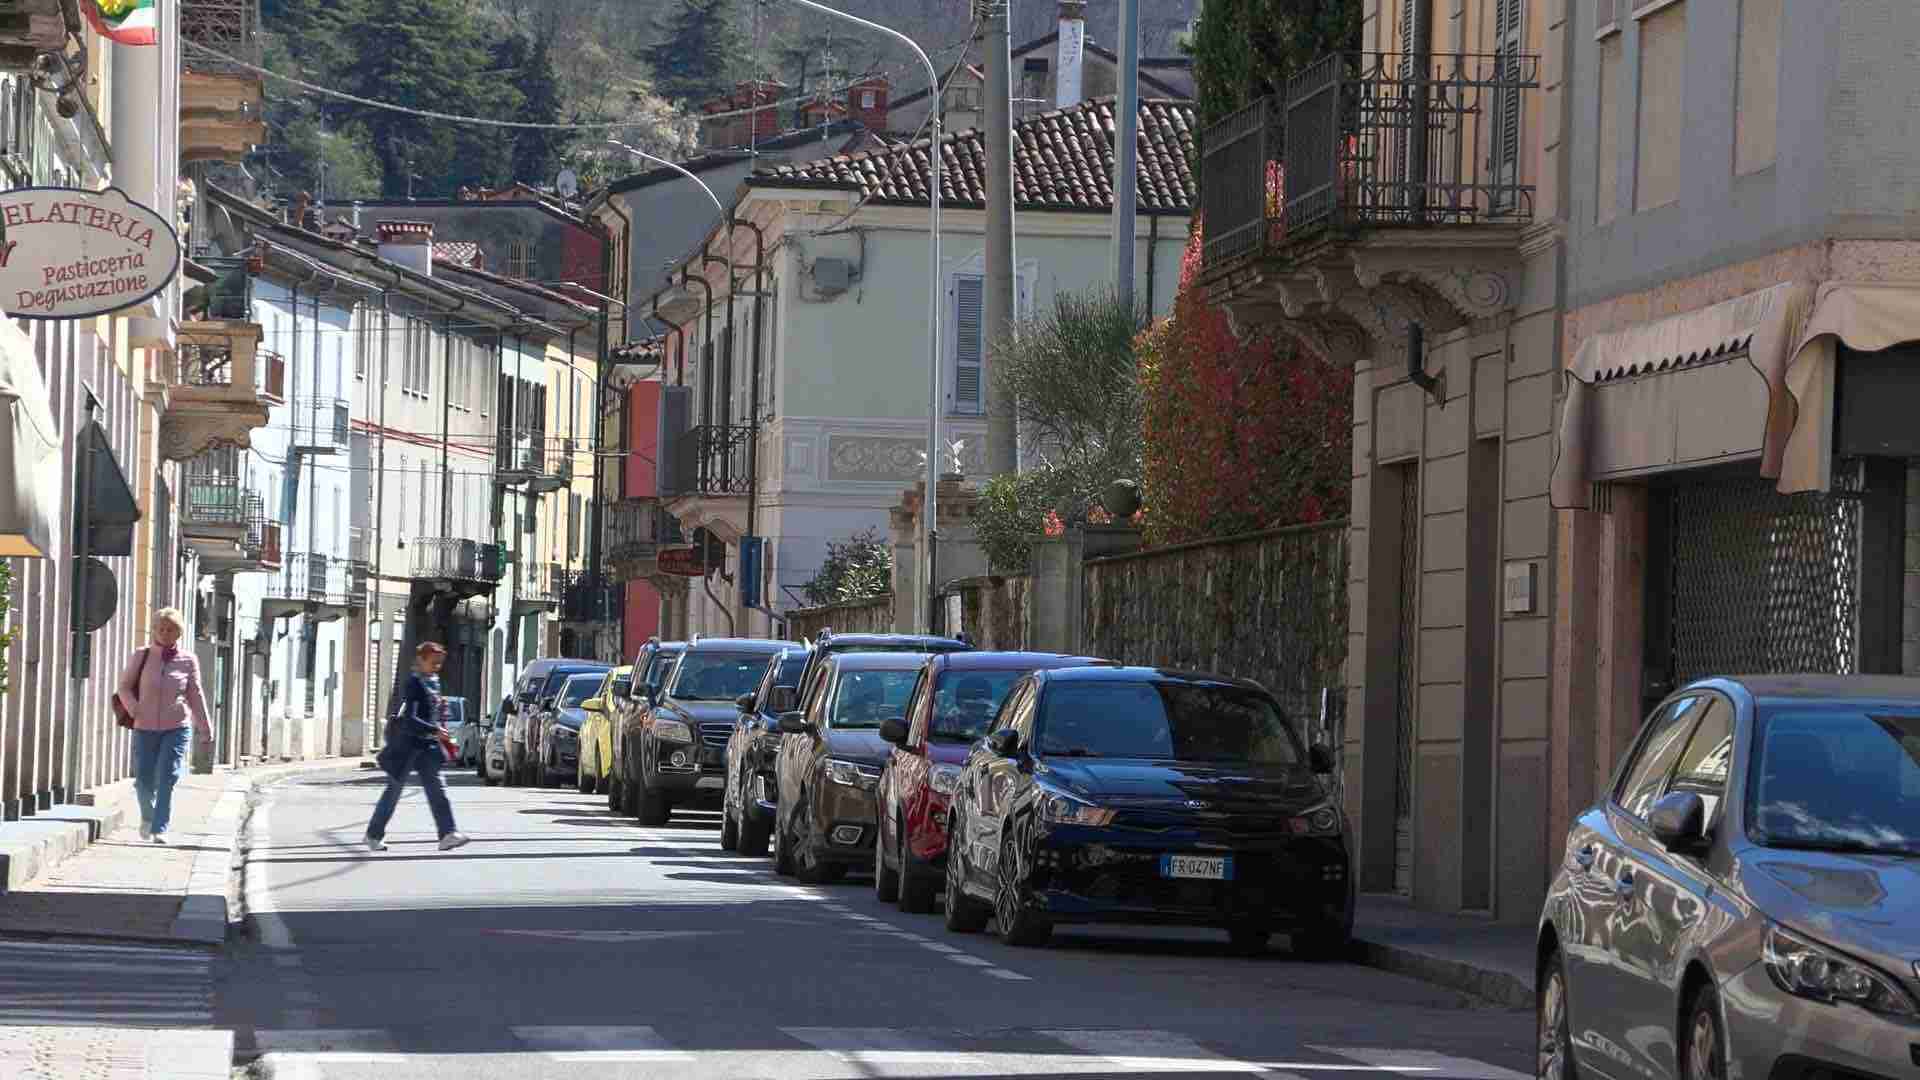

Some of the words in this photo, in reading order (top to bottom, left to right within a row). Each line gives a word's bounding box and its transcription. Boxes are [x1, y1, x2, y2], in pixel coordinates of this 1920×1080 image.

[4, 202, 155, 249] ELATERIA
[42, 249, 145, 287] Pasticceria
[16, 272, 148, 312] Degustazione
